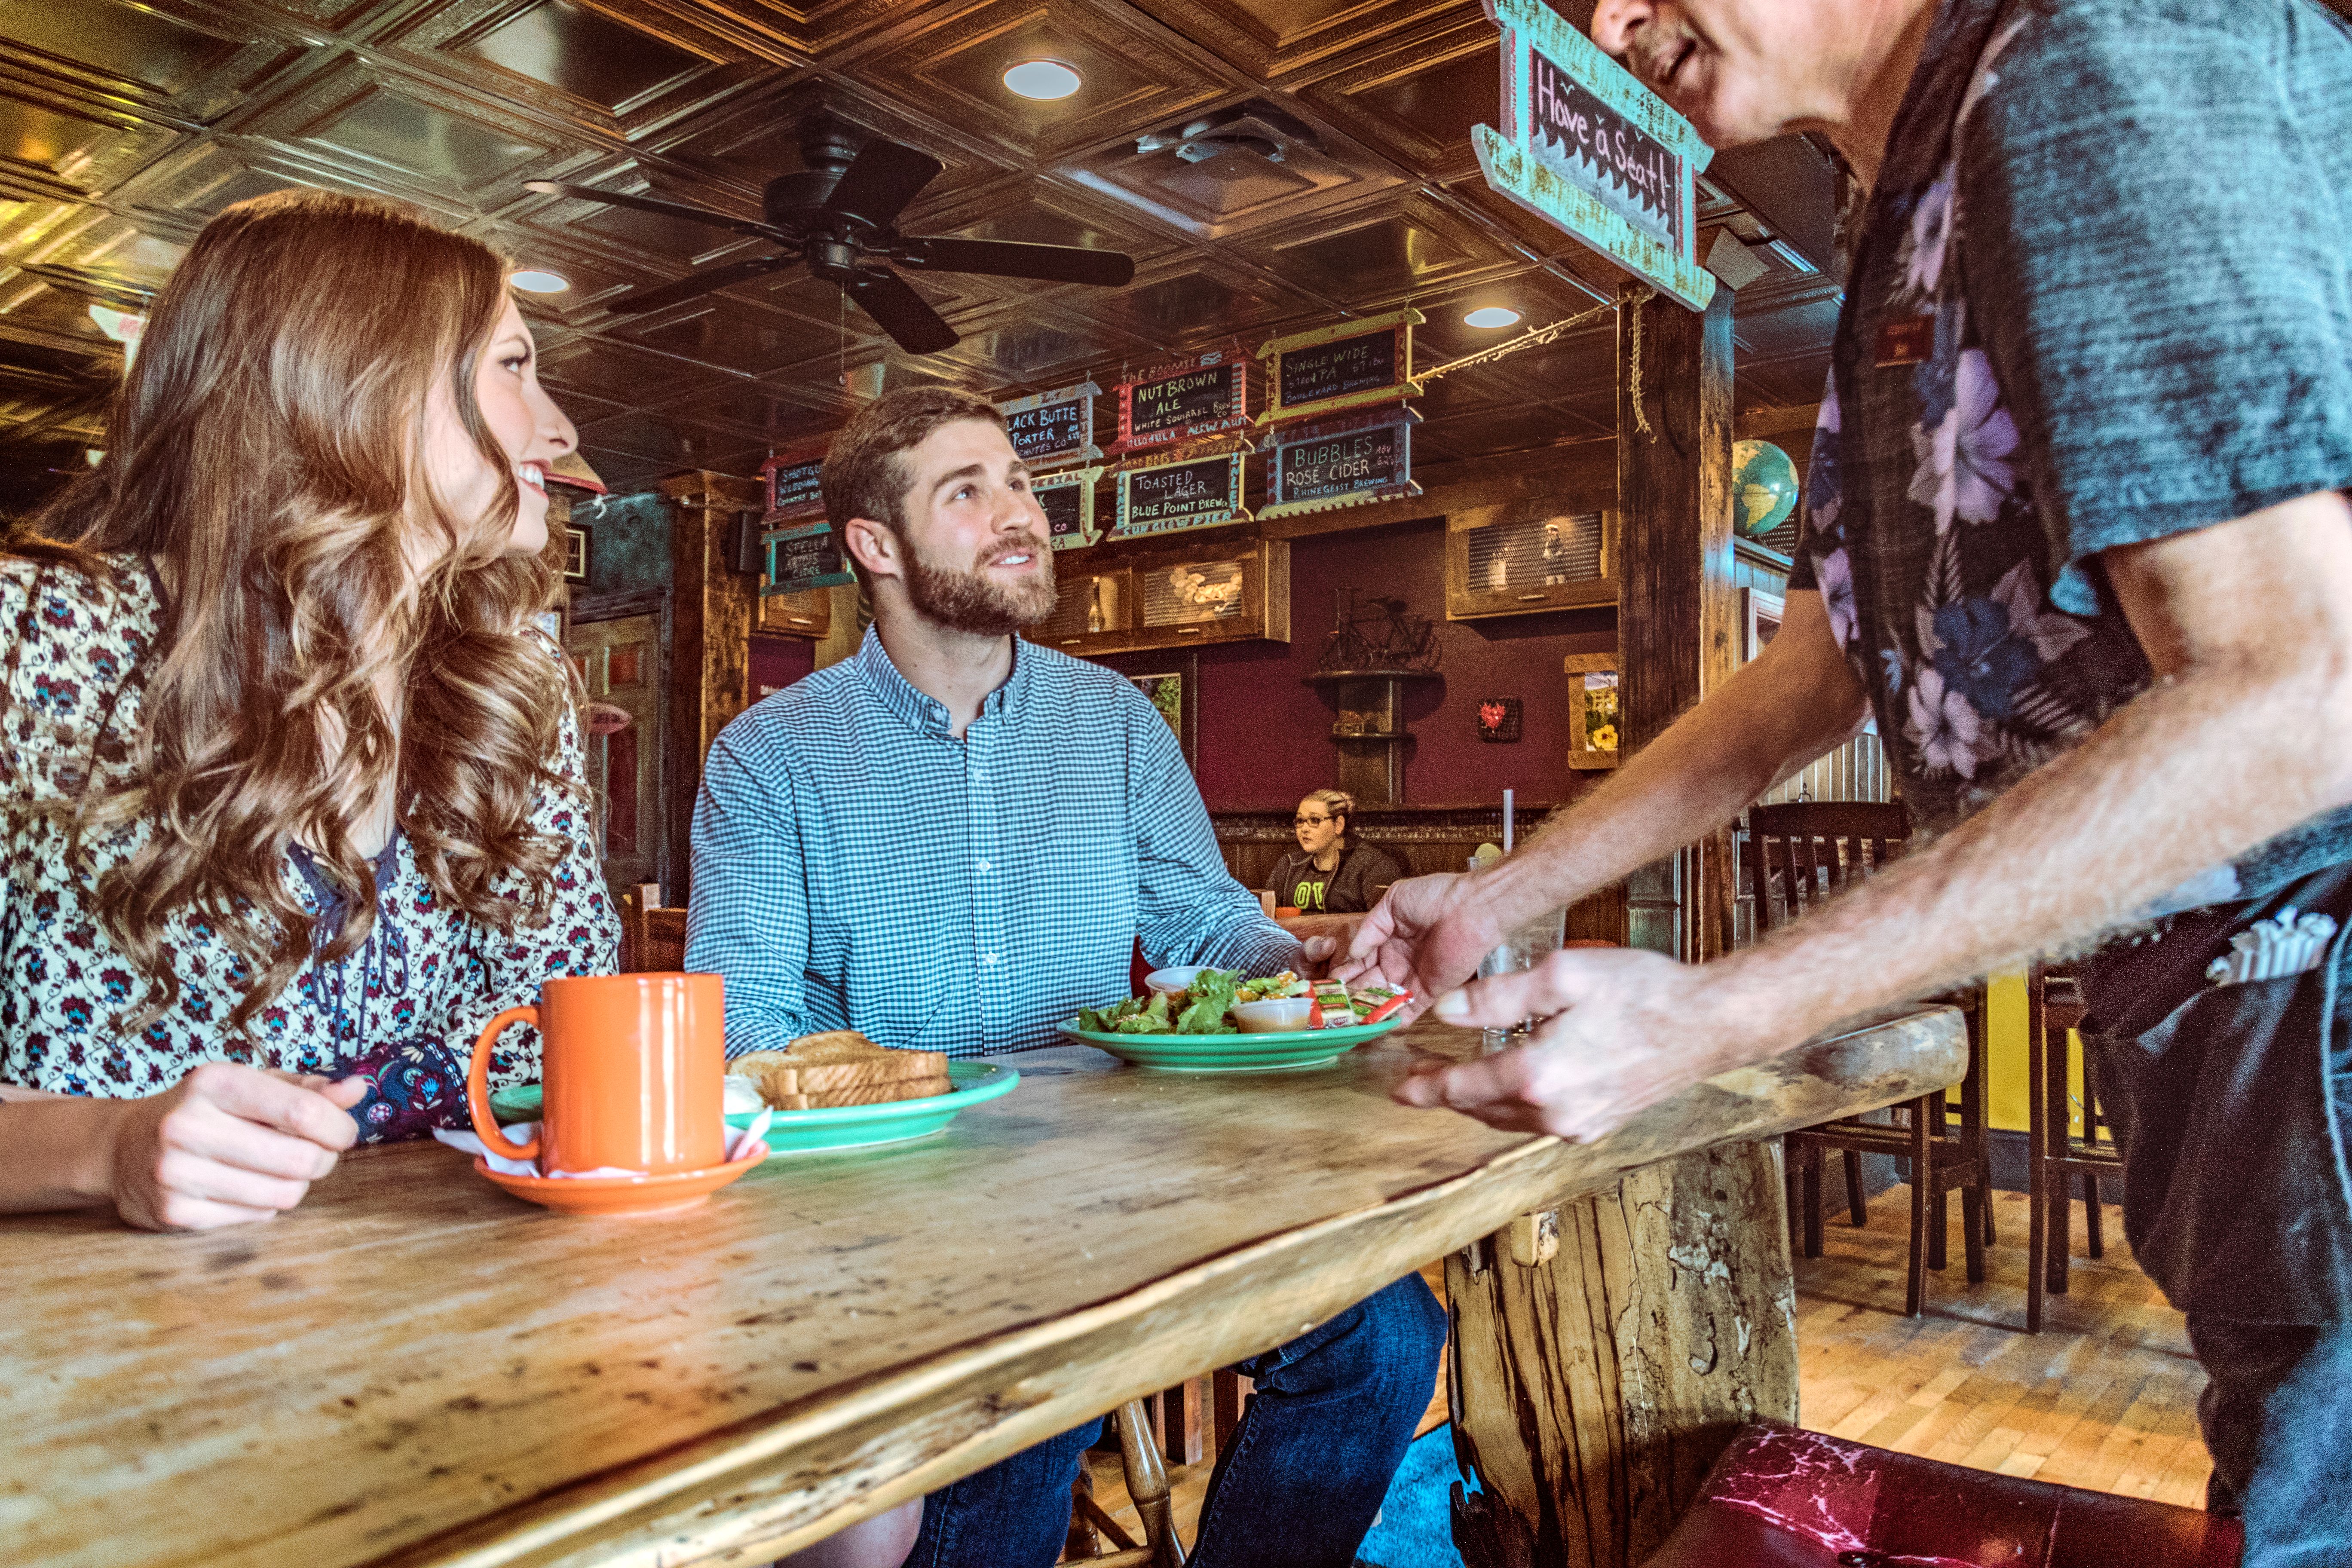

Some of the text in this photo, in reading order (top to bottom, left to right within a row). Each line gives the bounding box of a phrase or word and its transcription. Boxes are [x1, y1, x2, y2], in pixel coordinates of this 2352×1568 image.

[1537, 59, 1666, 209] Have a Seat!
[1286, 346, 1369, 377] SINGLE WIDE
[1139, 371, 1217, 403] NUT BROWN
[1285, 385, 1337, 404] BOULEVARD
[1156, 399, 1181, 415] ALE
[1007, 407, 1077, 432] LACK BUTTE
[1135, 419, 1160, 432] WHITE
[1166, 408, 1208, 424] SQUIRREL
[1013, 428, 1054, 450] PORTER
[1018, 443, 1050, 456] CHUTES
[1295, 436, 1372, 467] BUBBLES
[782, 465, 821, 482] SHOTGU
[1032, 474, 1082, 487] PERIAL
[1135, 471, 1193, 490] TOASTED
[1286, 466, 1320, 486] ROSÉ
[1329, 459, 1369, 480] CIDER
[1164, 481, 1206, 499] LAGER
[1230, 453, 1239, 514] INLET
[1293, 483, 1349, 499] RHINEGEIST
[1132, 504, 1159, 519] BLUE
[1163, 501, 1196, 515] POINT
[1193, 511, 1231, 526] PIER
[1054, 523, 1067, 532] CO
